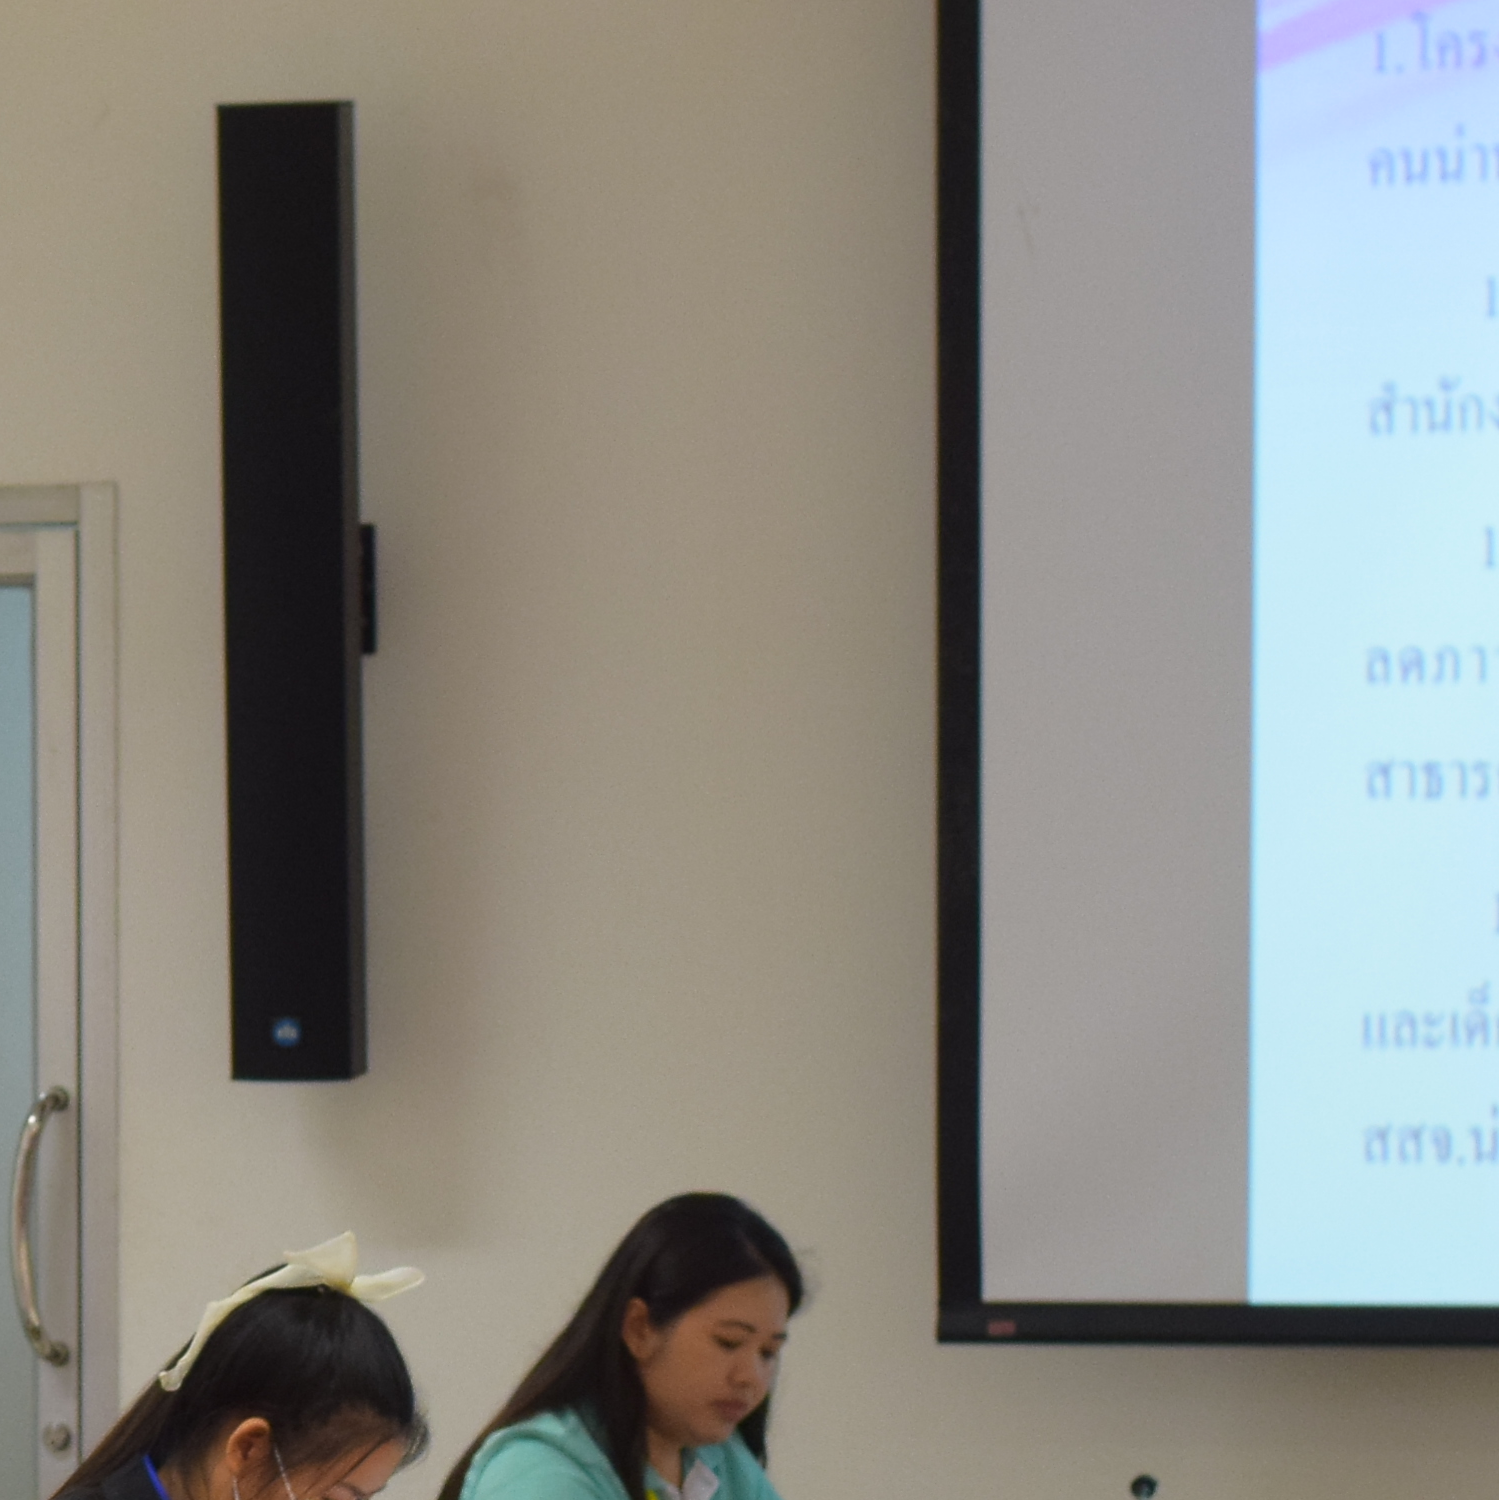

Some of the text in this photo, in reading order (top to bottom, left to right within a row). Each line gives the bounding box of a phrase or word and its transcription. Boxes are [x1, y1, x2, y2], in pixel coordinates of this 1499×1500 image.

[1373, 10, 1499, 74] 1.โคร
[1367, 121, 1499, 187] คนน่า
[1365, 645, 1499, 685] ลดภา
[1365, 758, 1499, 800] สาธาร
[1360, 980, 1499, 1050] และเด็
